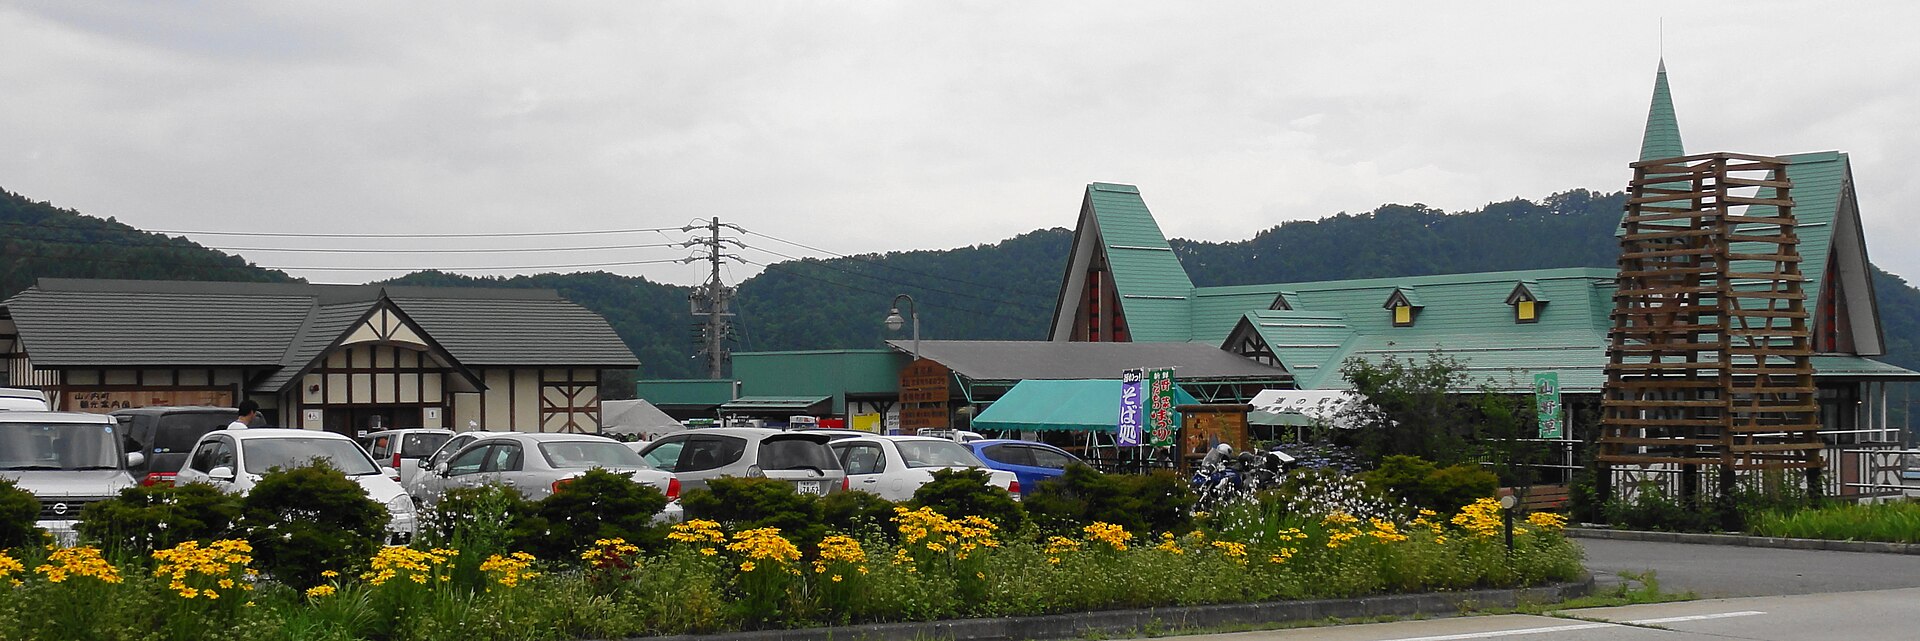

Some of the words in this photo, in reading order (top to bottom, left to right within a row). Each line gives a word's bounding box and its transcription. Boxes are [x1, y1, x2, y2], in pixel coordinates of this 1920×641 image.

[1119, 386, 1138, 444] そば処
[1537, 381, 1557, 435] 山野草
